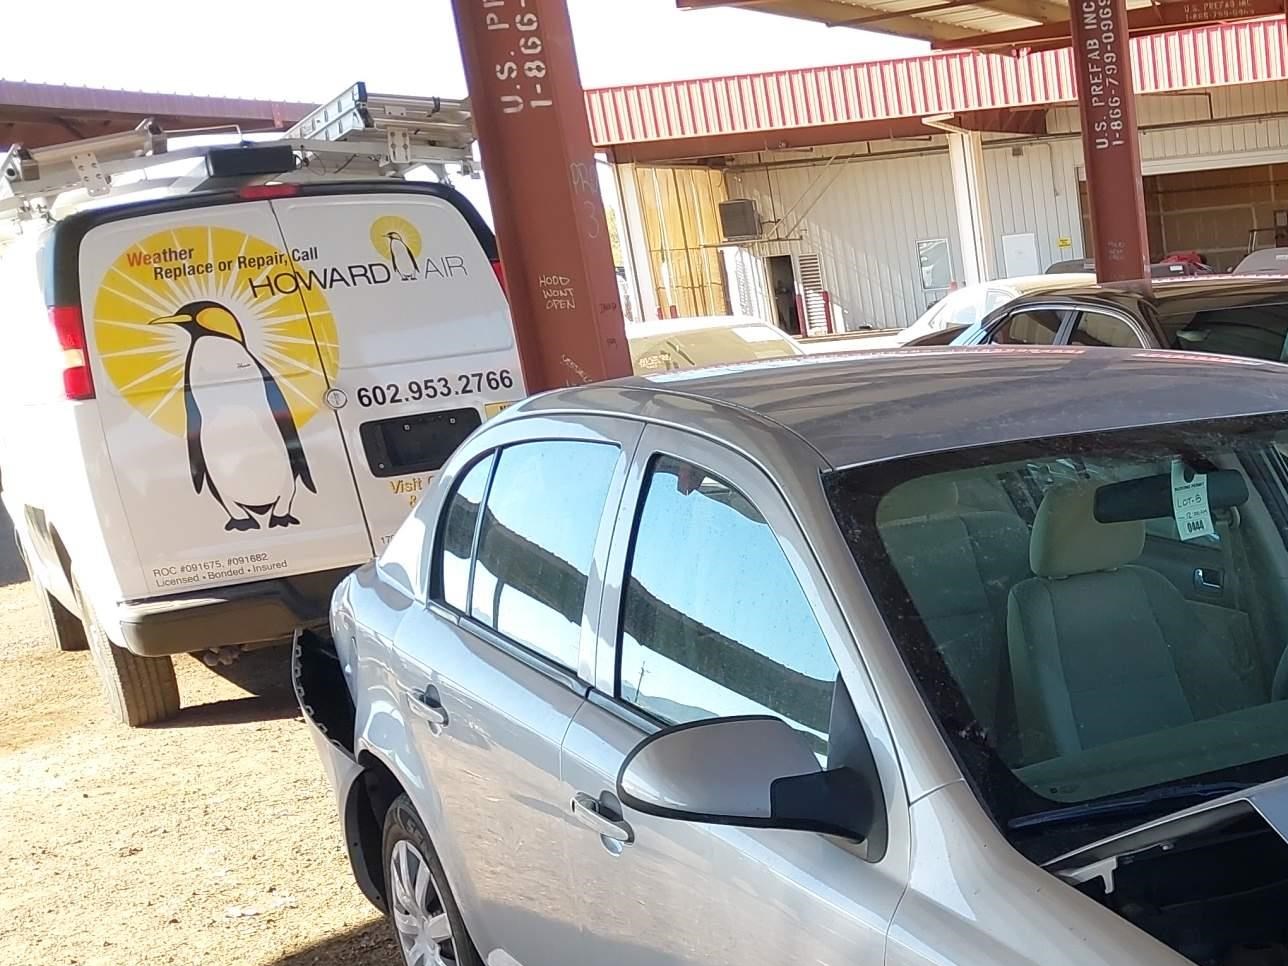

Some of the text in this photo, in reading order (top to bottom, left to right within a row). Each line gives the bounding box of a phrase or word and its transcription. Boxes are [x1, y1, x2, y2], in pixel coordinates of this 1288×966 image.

[496, 51, 525, 113] U.S.
[1086, 38, 1105, 107] PREFAB
[1095, 116, 1109, 149] U.S.
[126, 247, 195, 268] Weather
[153, 247, 319, 281] Replace or Repair, Call
[248, 255, 468, 299] HOWARD AIR
[538, 274, 570, 289] HOOD
[546, 298, 576, 310] OPEN
[357, 369, 514, 408] 602.953.2766
[390, 478, 423, 495] Visit
[152, 566, 177, 578] ROC
[156, 559, 288, 588] Licensed Bonded Insured
